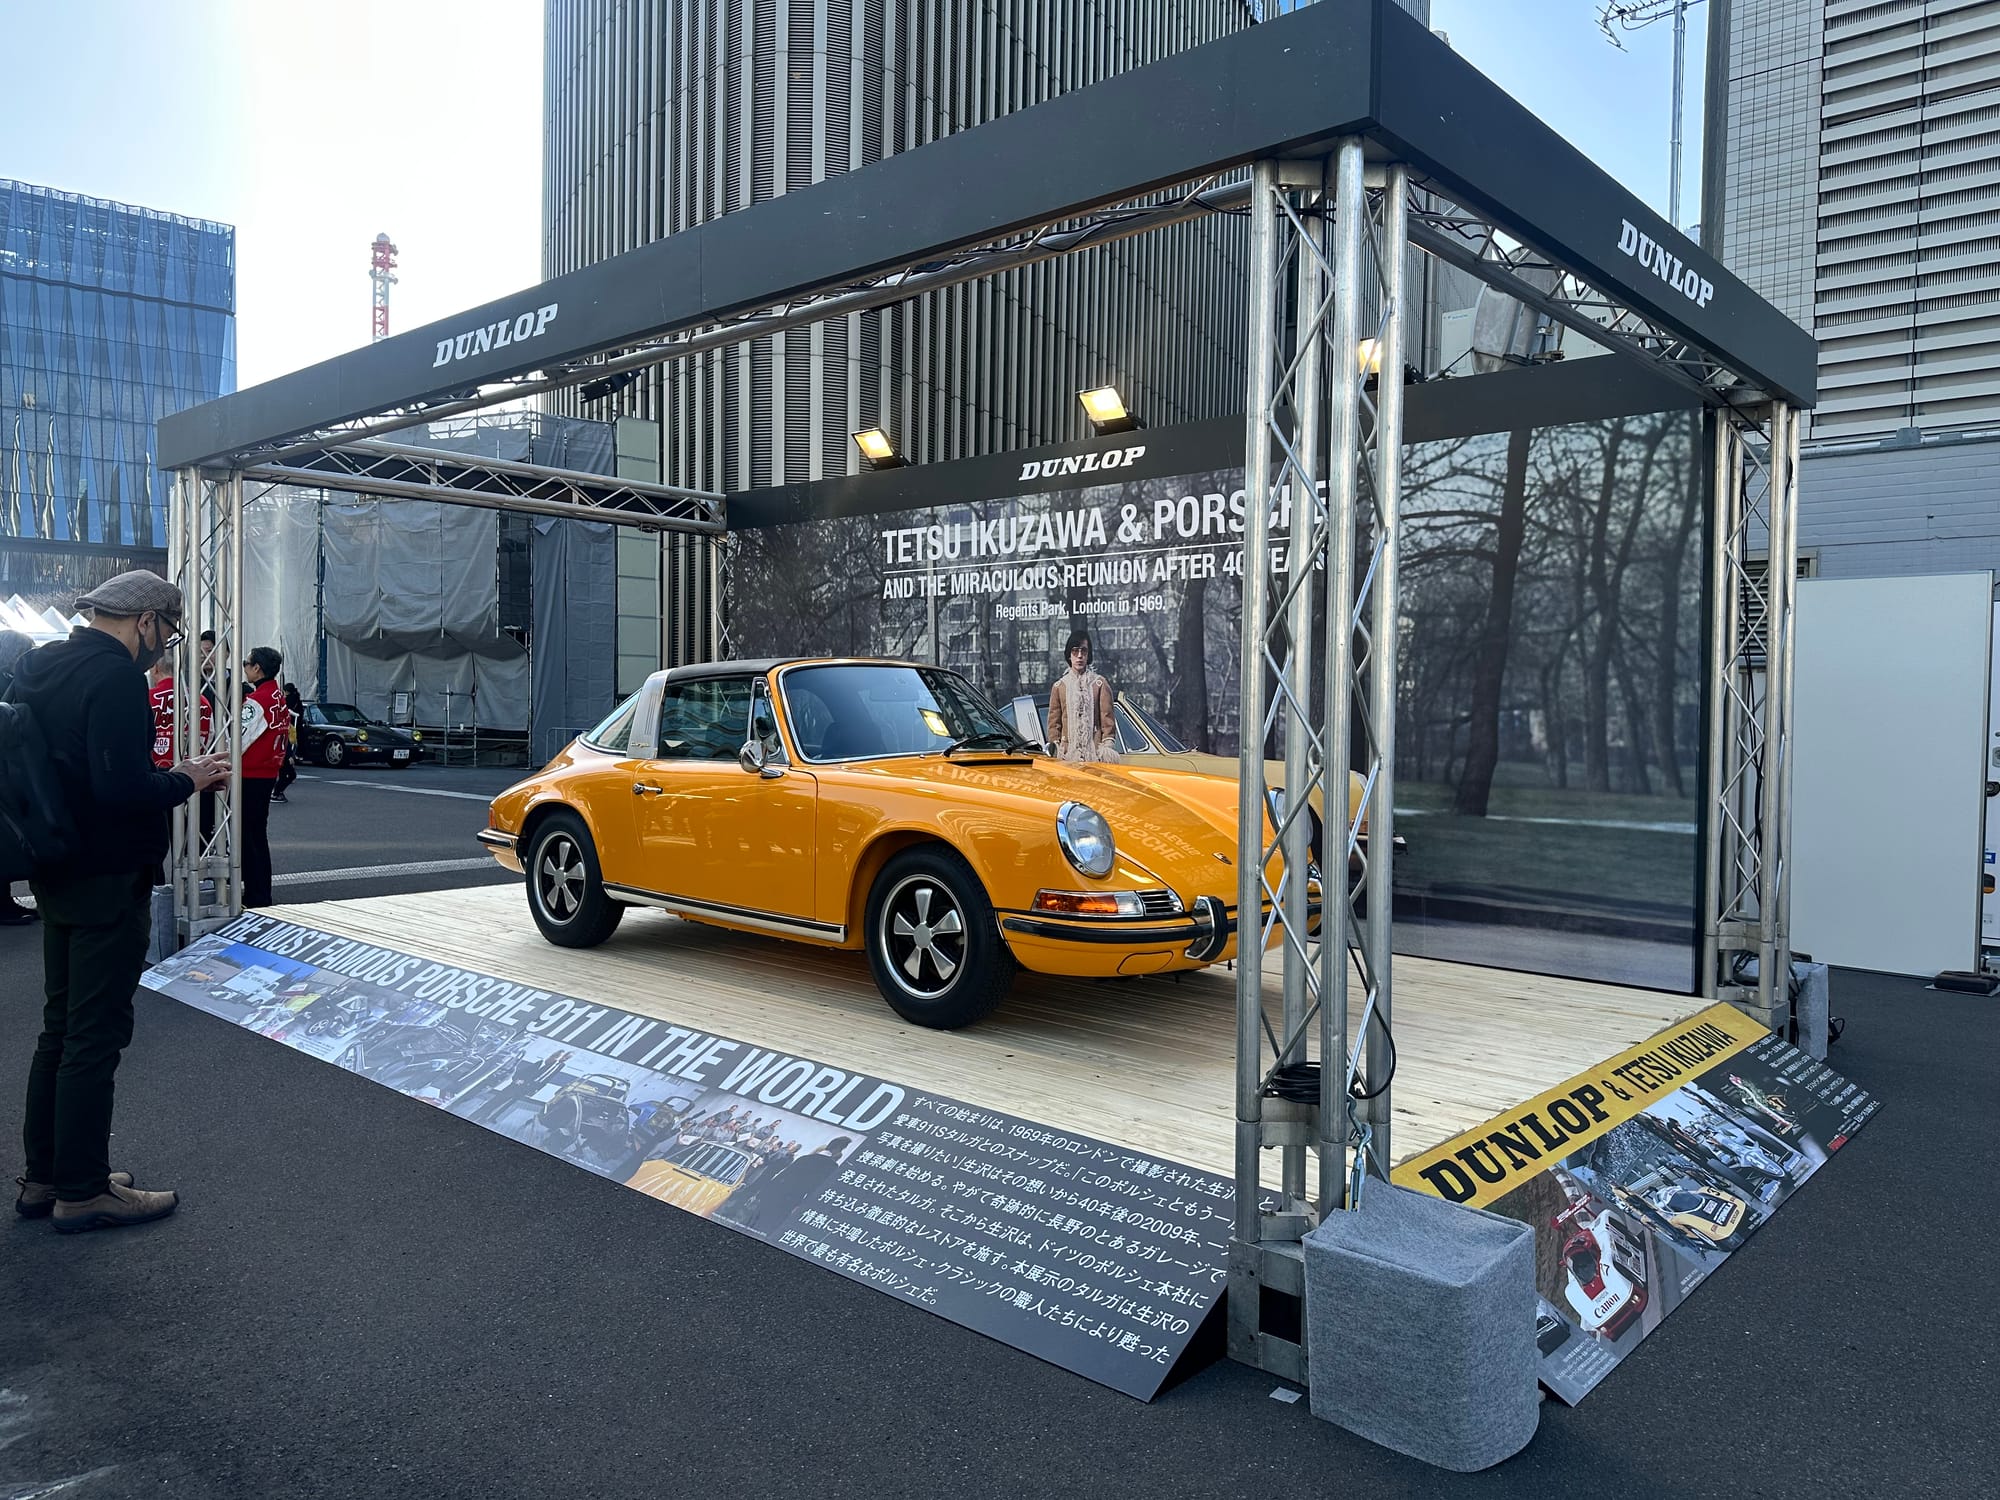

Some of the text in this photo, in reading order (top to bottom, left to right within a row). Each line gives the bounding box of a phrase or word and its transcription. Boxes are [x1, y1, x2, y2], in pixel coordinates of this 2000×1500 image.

[1617, 218, 1714, 309] DUNLOP
[432, 303, 559, 368] DUNLOP
[1018, 445, 1146, 481] DUNLOP
[881, 480, 1327, 564] TETSU IKUZAWA & PORSE
[882, 577, 914, 600] AND
[918, 574, 947, 598] THE
[950, 565, 1059, 596] MIRACULOUS
[1062, 558, 1147, 588] REUNION
[1151, 552, 1217, 582] AFTER
[995, 594, 1166, 620] Regents Park, London in 1969.
[215, 911, 906, 1132] THE MOST FAMOUS PORSCHE 911 IN THE WORLD
[1657, 1021, 1739, 1070] IKUZAWA
[1600, 1079, 1635, 1101] &
[1611, 1053, 1682, 1095] TETSU
[1418, 1083, 1610, 1204] DUNLOP
[1594, 1292, 1621, 1319] Canon
